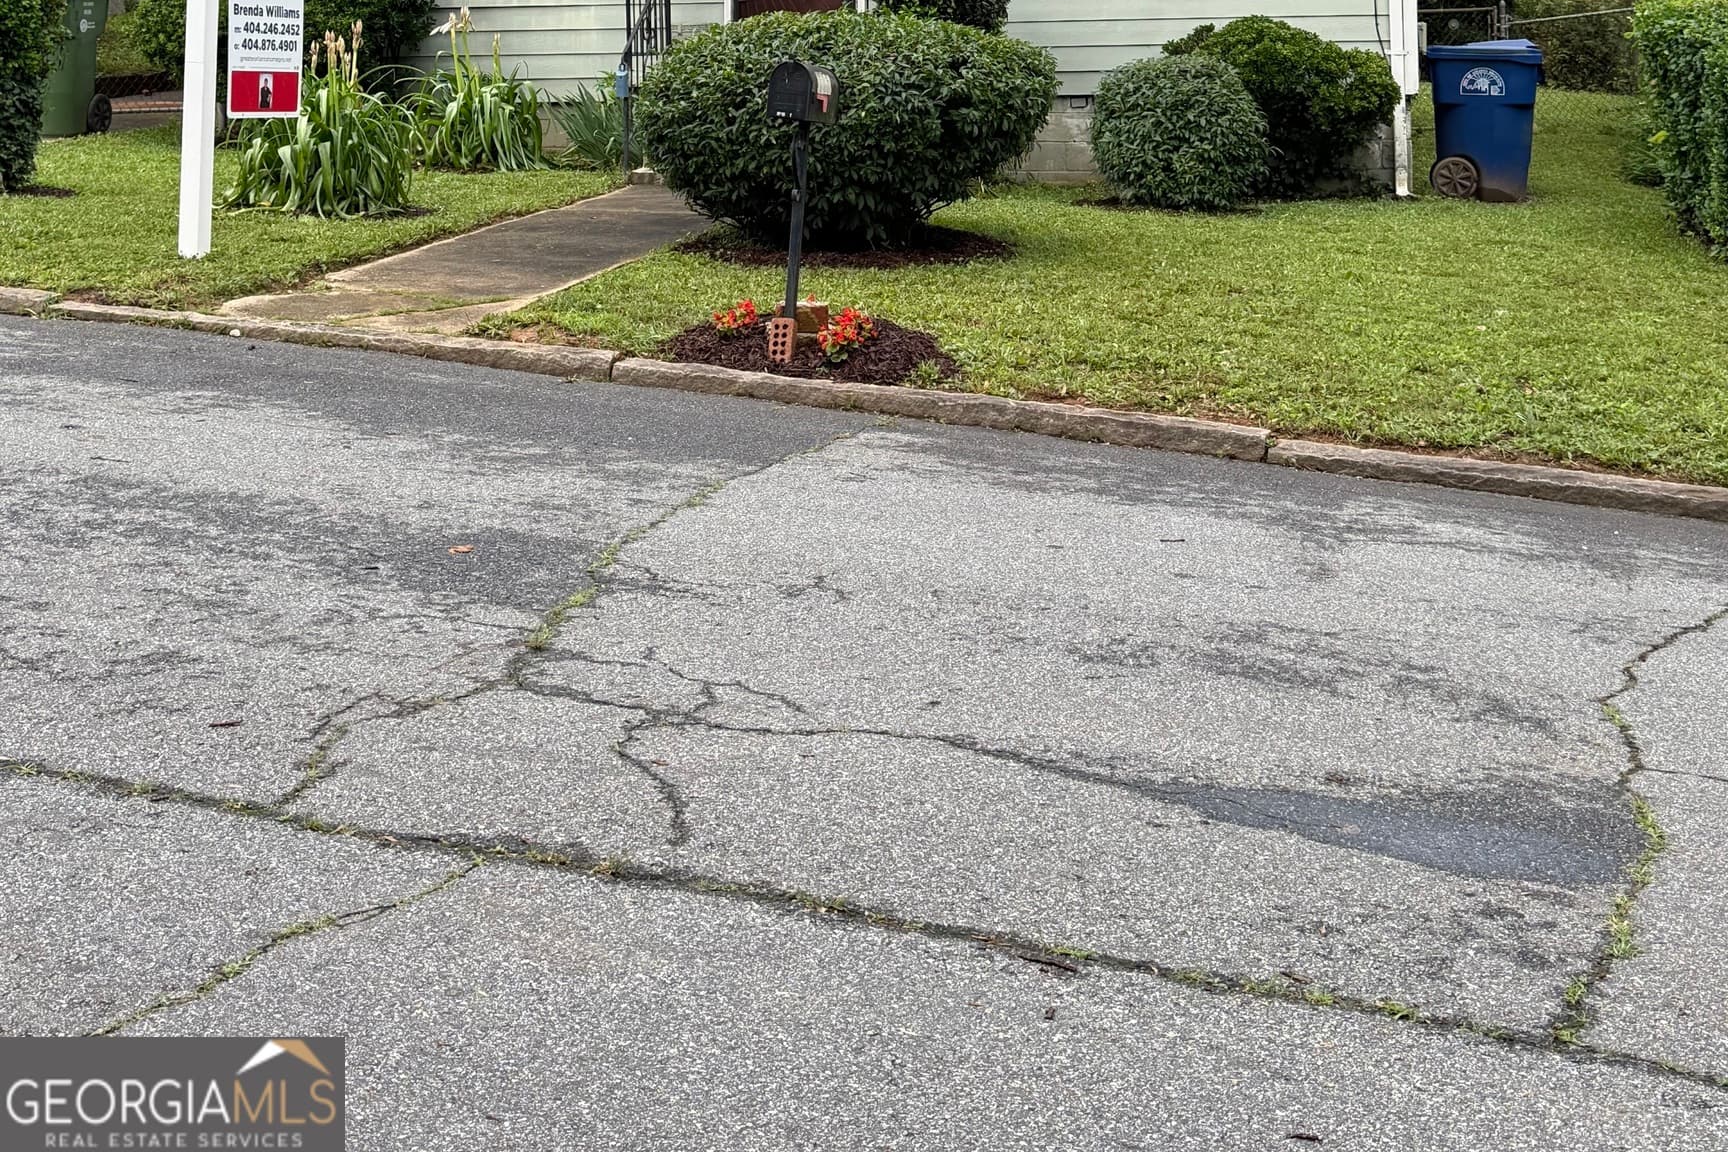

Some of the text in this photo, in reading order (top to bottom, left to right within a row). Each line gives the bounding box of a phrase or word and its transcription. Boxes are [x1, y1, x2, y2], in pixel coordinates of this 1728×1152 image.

[233, 3, 300, 19] Brenda Williams
[243, 21, 300, 36] 404.246.2452
[241, 38, 297, 52] 404.876.4901
